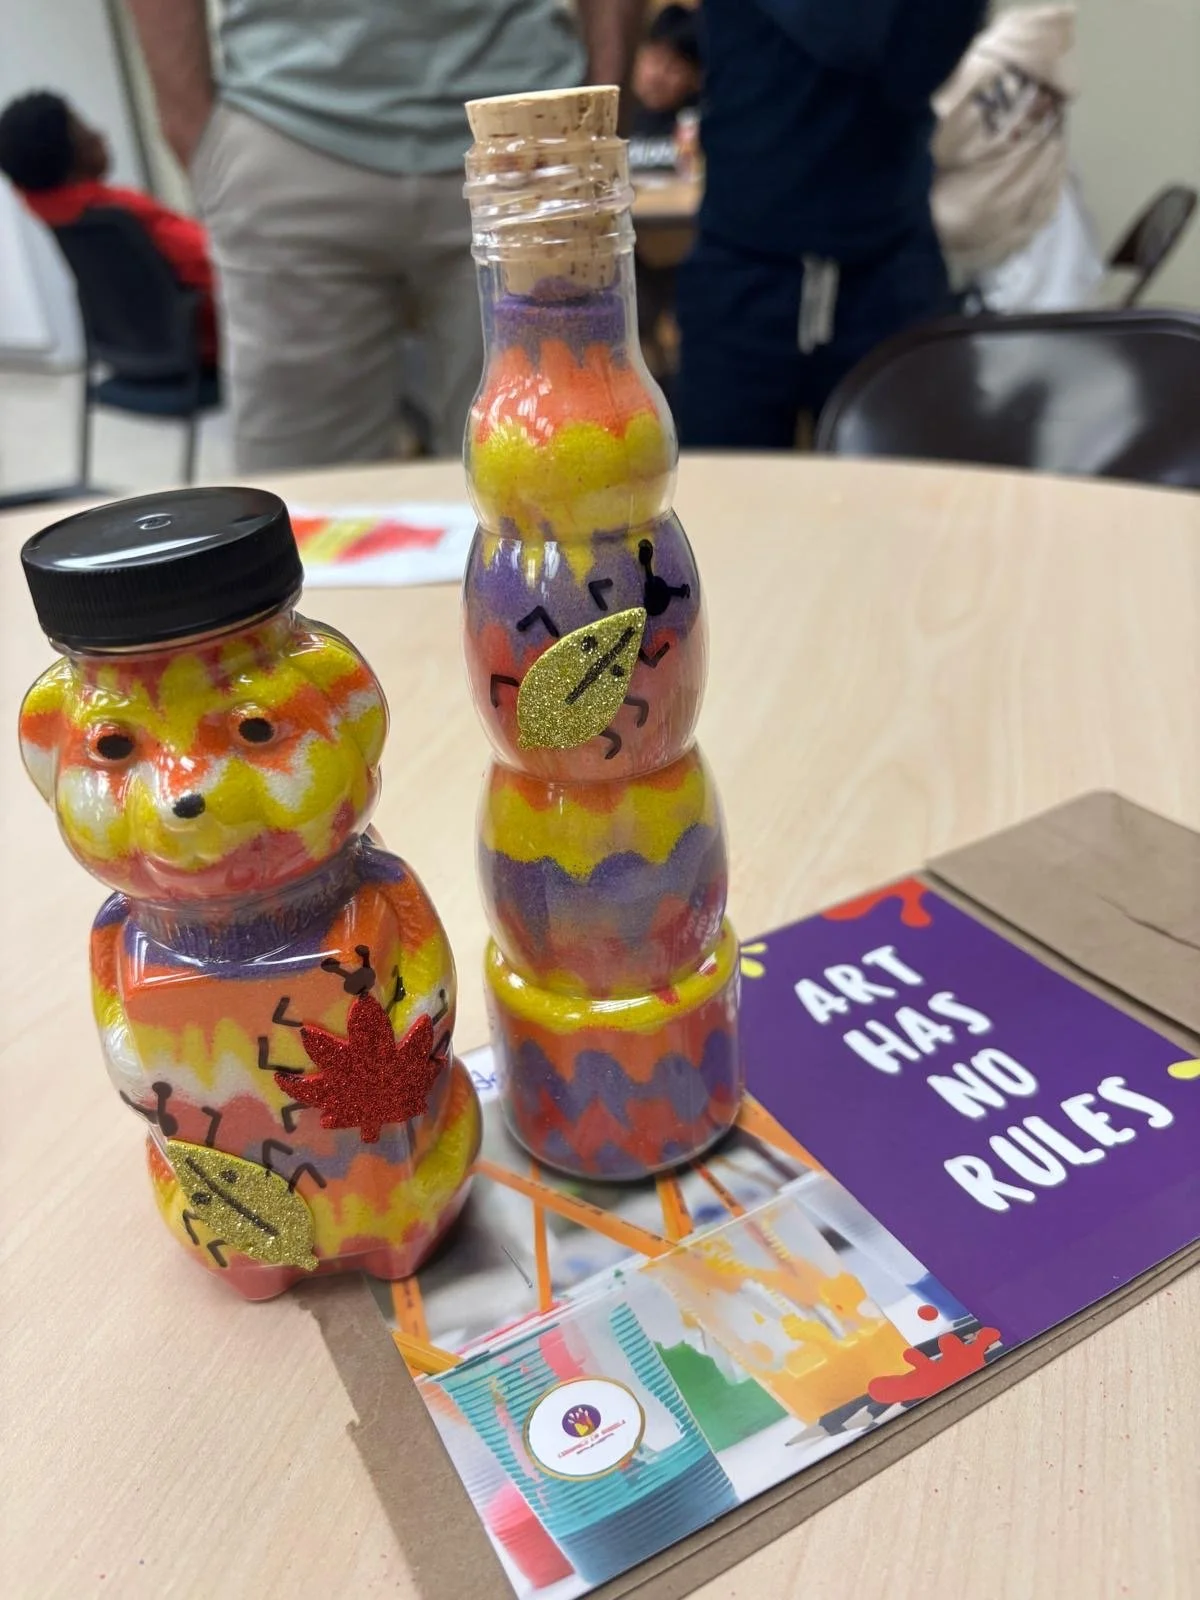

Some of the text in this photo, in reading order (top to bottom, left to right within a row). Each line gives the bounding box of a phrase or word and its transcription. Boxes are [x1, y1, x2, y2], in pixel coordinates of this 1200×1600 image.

[794, 945, 923, 1024] ART
[843, 991, 992, 1074] HAS
[926, 1047, 1038, 1118] NO
[943, 1076, 1174, 1211] RULES
